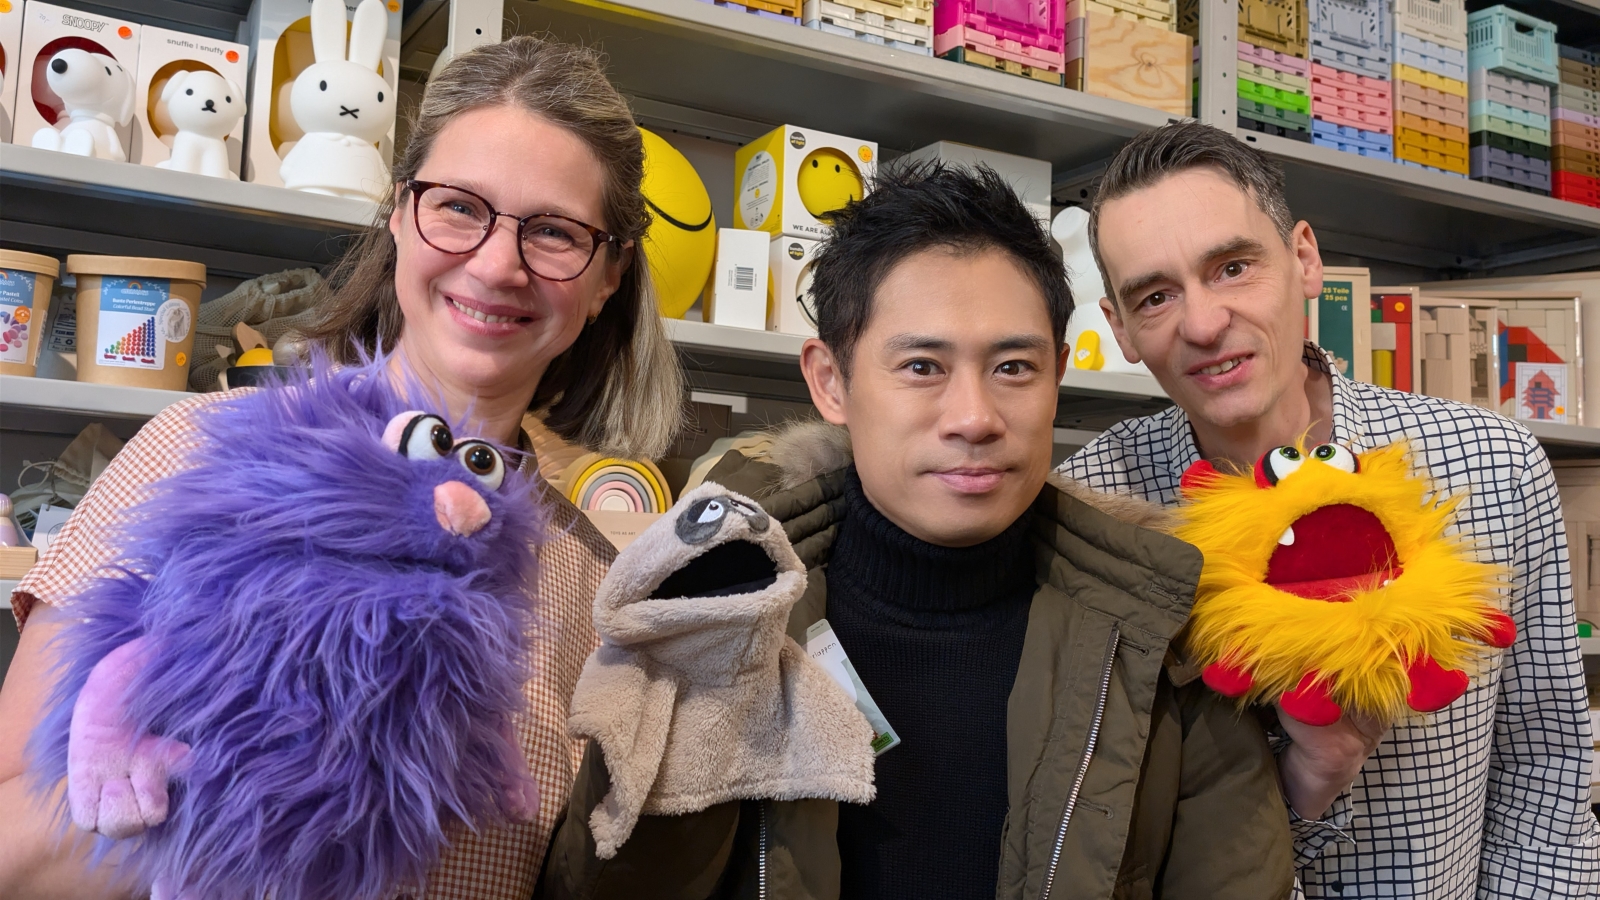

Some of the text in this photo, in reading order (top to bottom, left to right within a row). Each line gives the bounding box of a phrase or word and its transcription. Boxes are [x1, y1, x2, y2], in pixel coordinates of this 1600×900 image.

[61, 14, 106, 33] SNOOPY
[166, 38, 194, 49] snuffie
[200, 45, 224, 56] snuffy
[805, 226, 818, 234] ARE
[3, 290, 20, 298] Pastell
[126, 298, 156, 307] Perlentreppe
